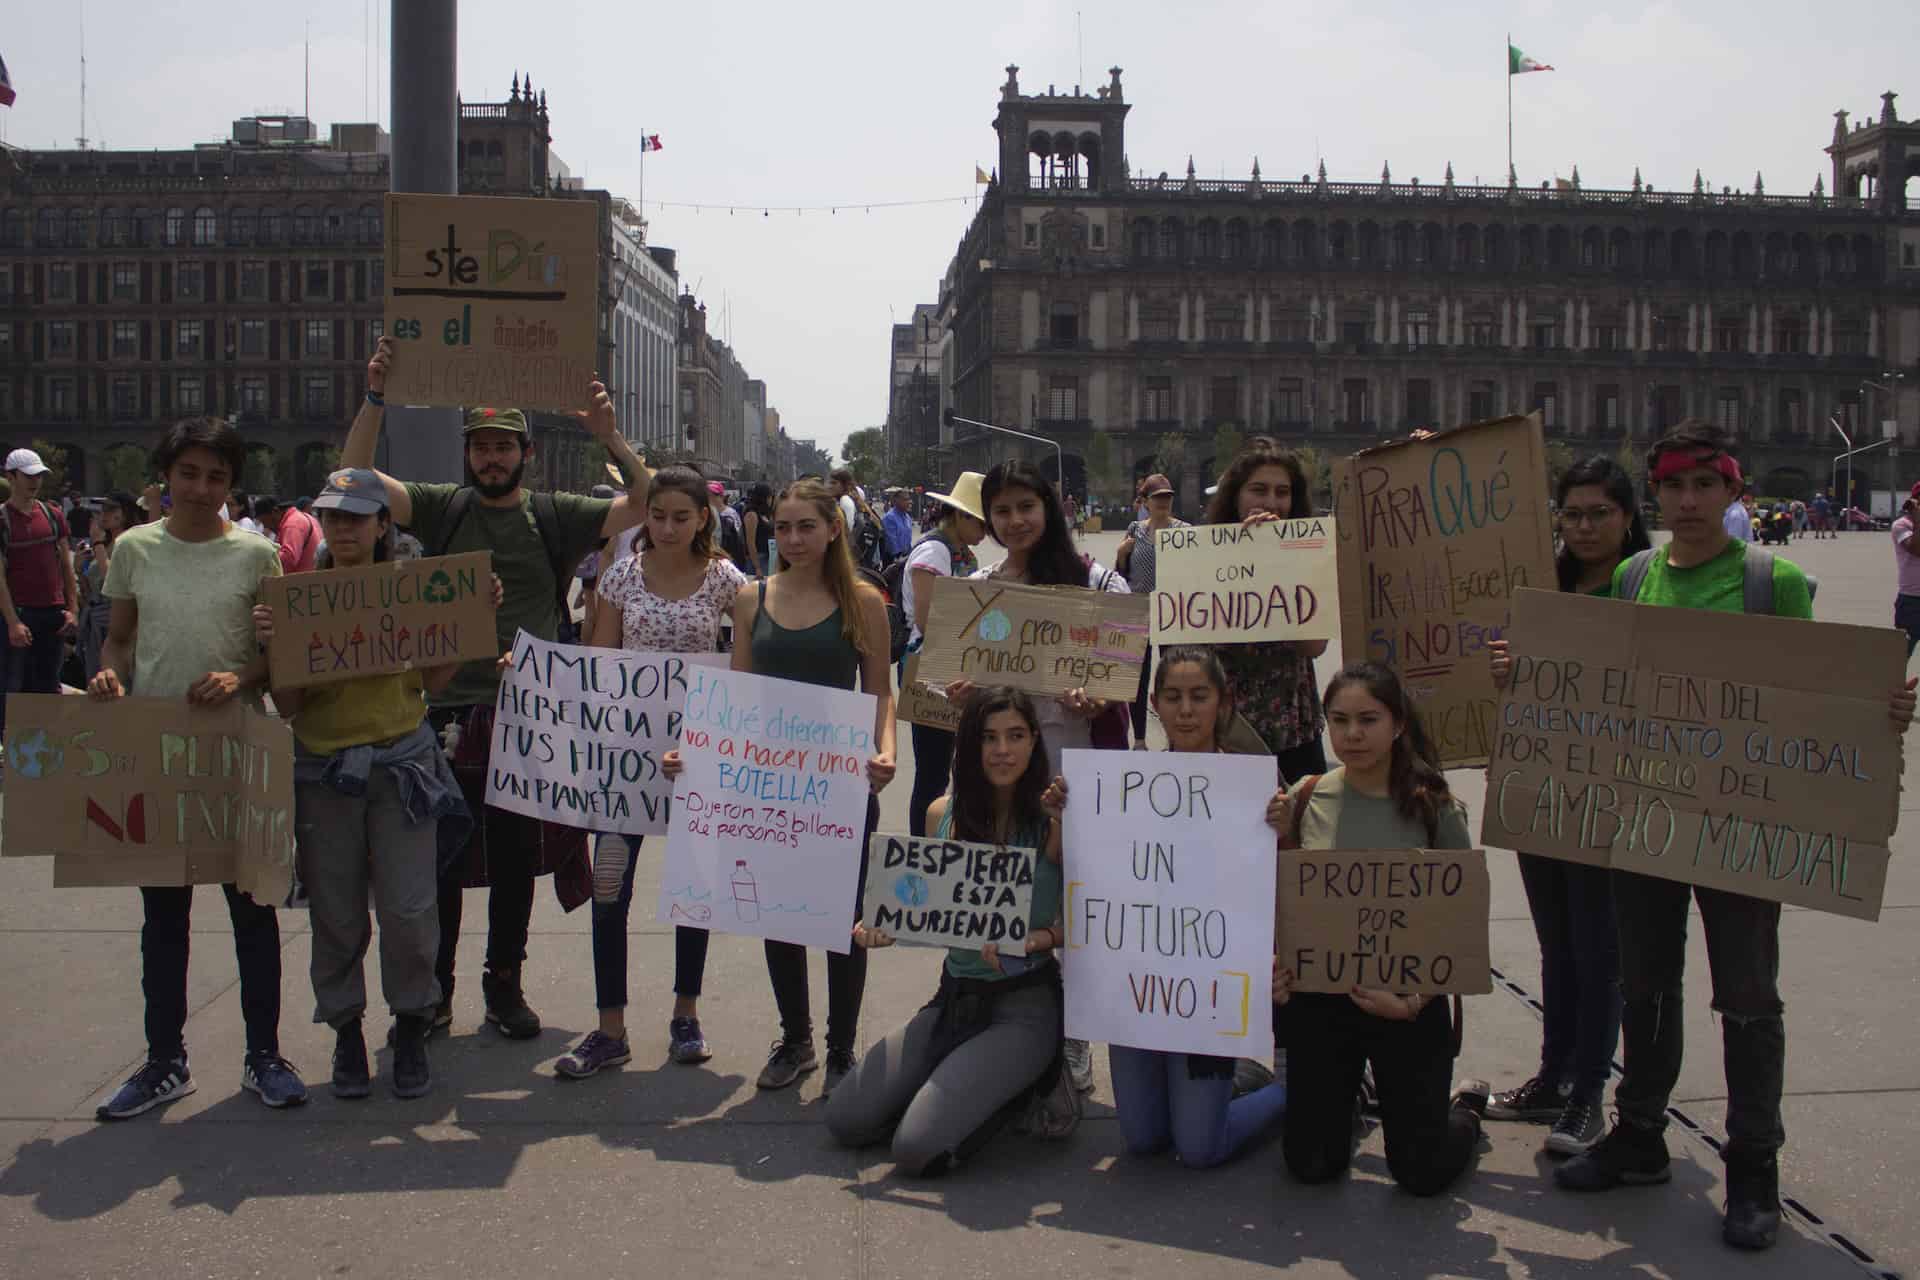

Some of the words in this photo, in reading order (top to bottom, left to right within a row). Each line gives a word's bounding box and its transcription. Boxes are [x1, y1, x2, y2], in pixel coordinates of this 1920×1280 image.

[394, 317, 422, 340] es
[443, 303, 471, 346] el
[1160, 529, 1199, 552] POR
[1211, 526, 1254, 546] UNA
[1273, 519, 1326, 539] VIDA
[1215, 563, 1255, 583] CON
[1158, 584, 1319, 632] DIGNIDAD
[1019, 617, 1063, 646] creo
[1405, 619, 1451, 663] NO
[547, 650, 688, 700] MEJOR
[1054, 655, 1120, 688] mejor
[1511, 655, 1584, 704] POR
[1601, 668, 1638, 709] EL
[1656, 673, 1708, 719] FIN
[1720, 681, 1770, 724] DEL
[500, 680, 652, 739] HERENCIA
[765, 707, 869, 752] diferencia
[498, 721, 555, 763] TUS
[570, 738, 658, 788] HIJOS
[684, 728, 710, 748] va
[718, 737, 736, 758] a
[744, 739, 809, 772] hacer
[818, 752, 861, 778] una
[1503, 702, 1724, 760] CALENTAMIENTO
[1744, 728, 1873, 783] GLOBAL
[718, 762, 830, 809] BOTELLA?
[1498, 732, 1553, 765] POR
[1567, 744, 1599, 777] EL
[1616, 751, 1698, 793] INICIO
[1719, 764, 1777, 803] DEL
[494, 768, 529, 801] UN
[536, 778, 630, 821] PLANETA
[85, 791, 161, 846] NO
[687, 816, 710, 836] de
[717, 821, 800, 848] personas
[792, 812, 856, 840] billones
[1495, 769, 1676, 858] CAMBIO
[1691, 807, 1865, 904] MUNDIAL
[883, 837, 1033, 887] DESPIERTA
[1131, 839, 1176, 884] UN
[1299, 861, 1463, 898] PROTESTO
[952, 881, 1017, 908] ESTA
[874, 903, 1026, 941] MURIENDO
[1084, 898, 1227, 959] FUTURO
[1357, 907, 1409, 932] POR
[1296, 948, 1454, 985] FUTURO
[1357, 933, 1390, 955] MI
